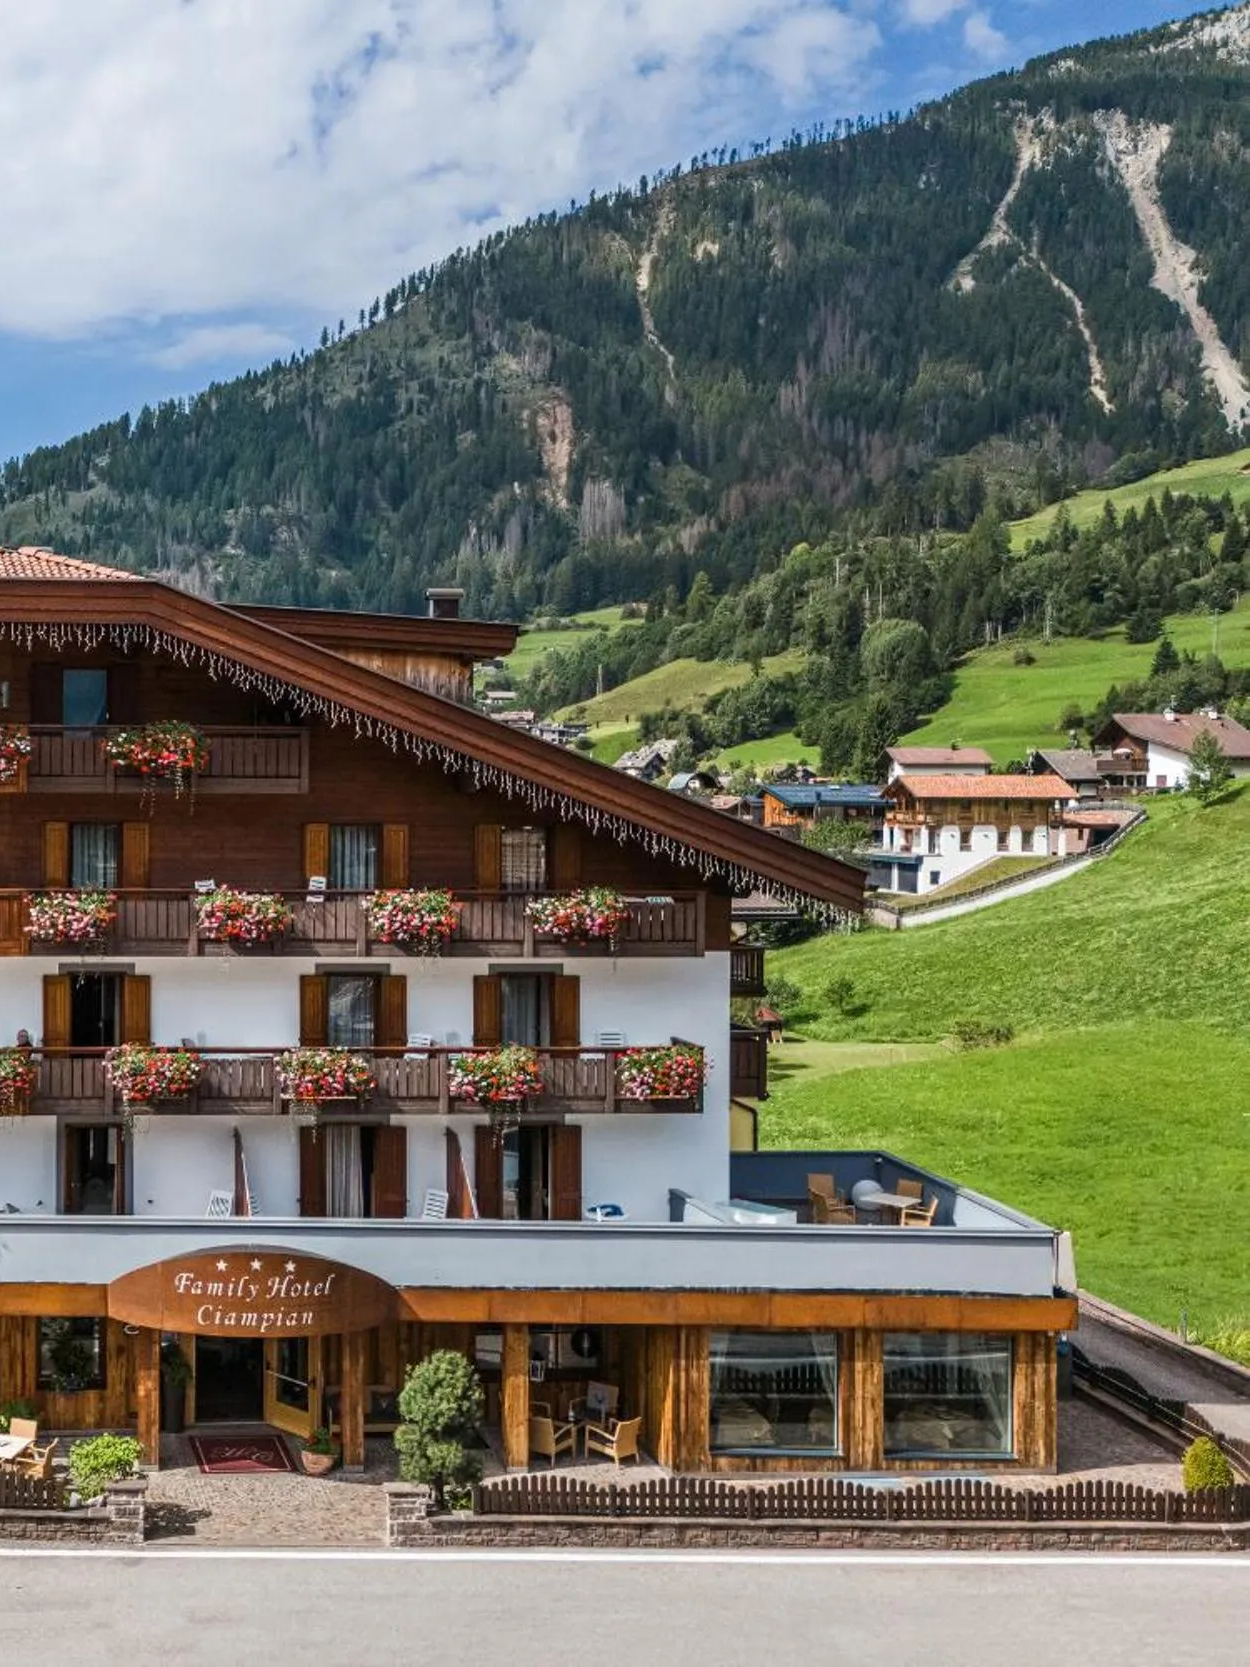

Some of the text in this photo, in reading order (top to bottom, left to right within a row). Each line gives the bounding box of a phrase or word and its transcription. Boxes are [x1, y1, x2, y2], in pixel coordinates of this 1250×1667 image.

[174, 1272, 335, 1301] Family Hotel
[197, 1305, 313, 1332] Ciampian
